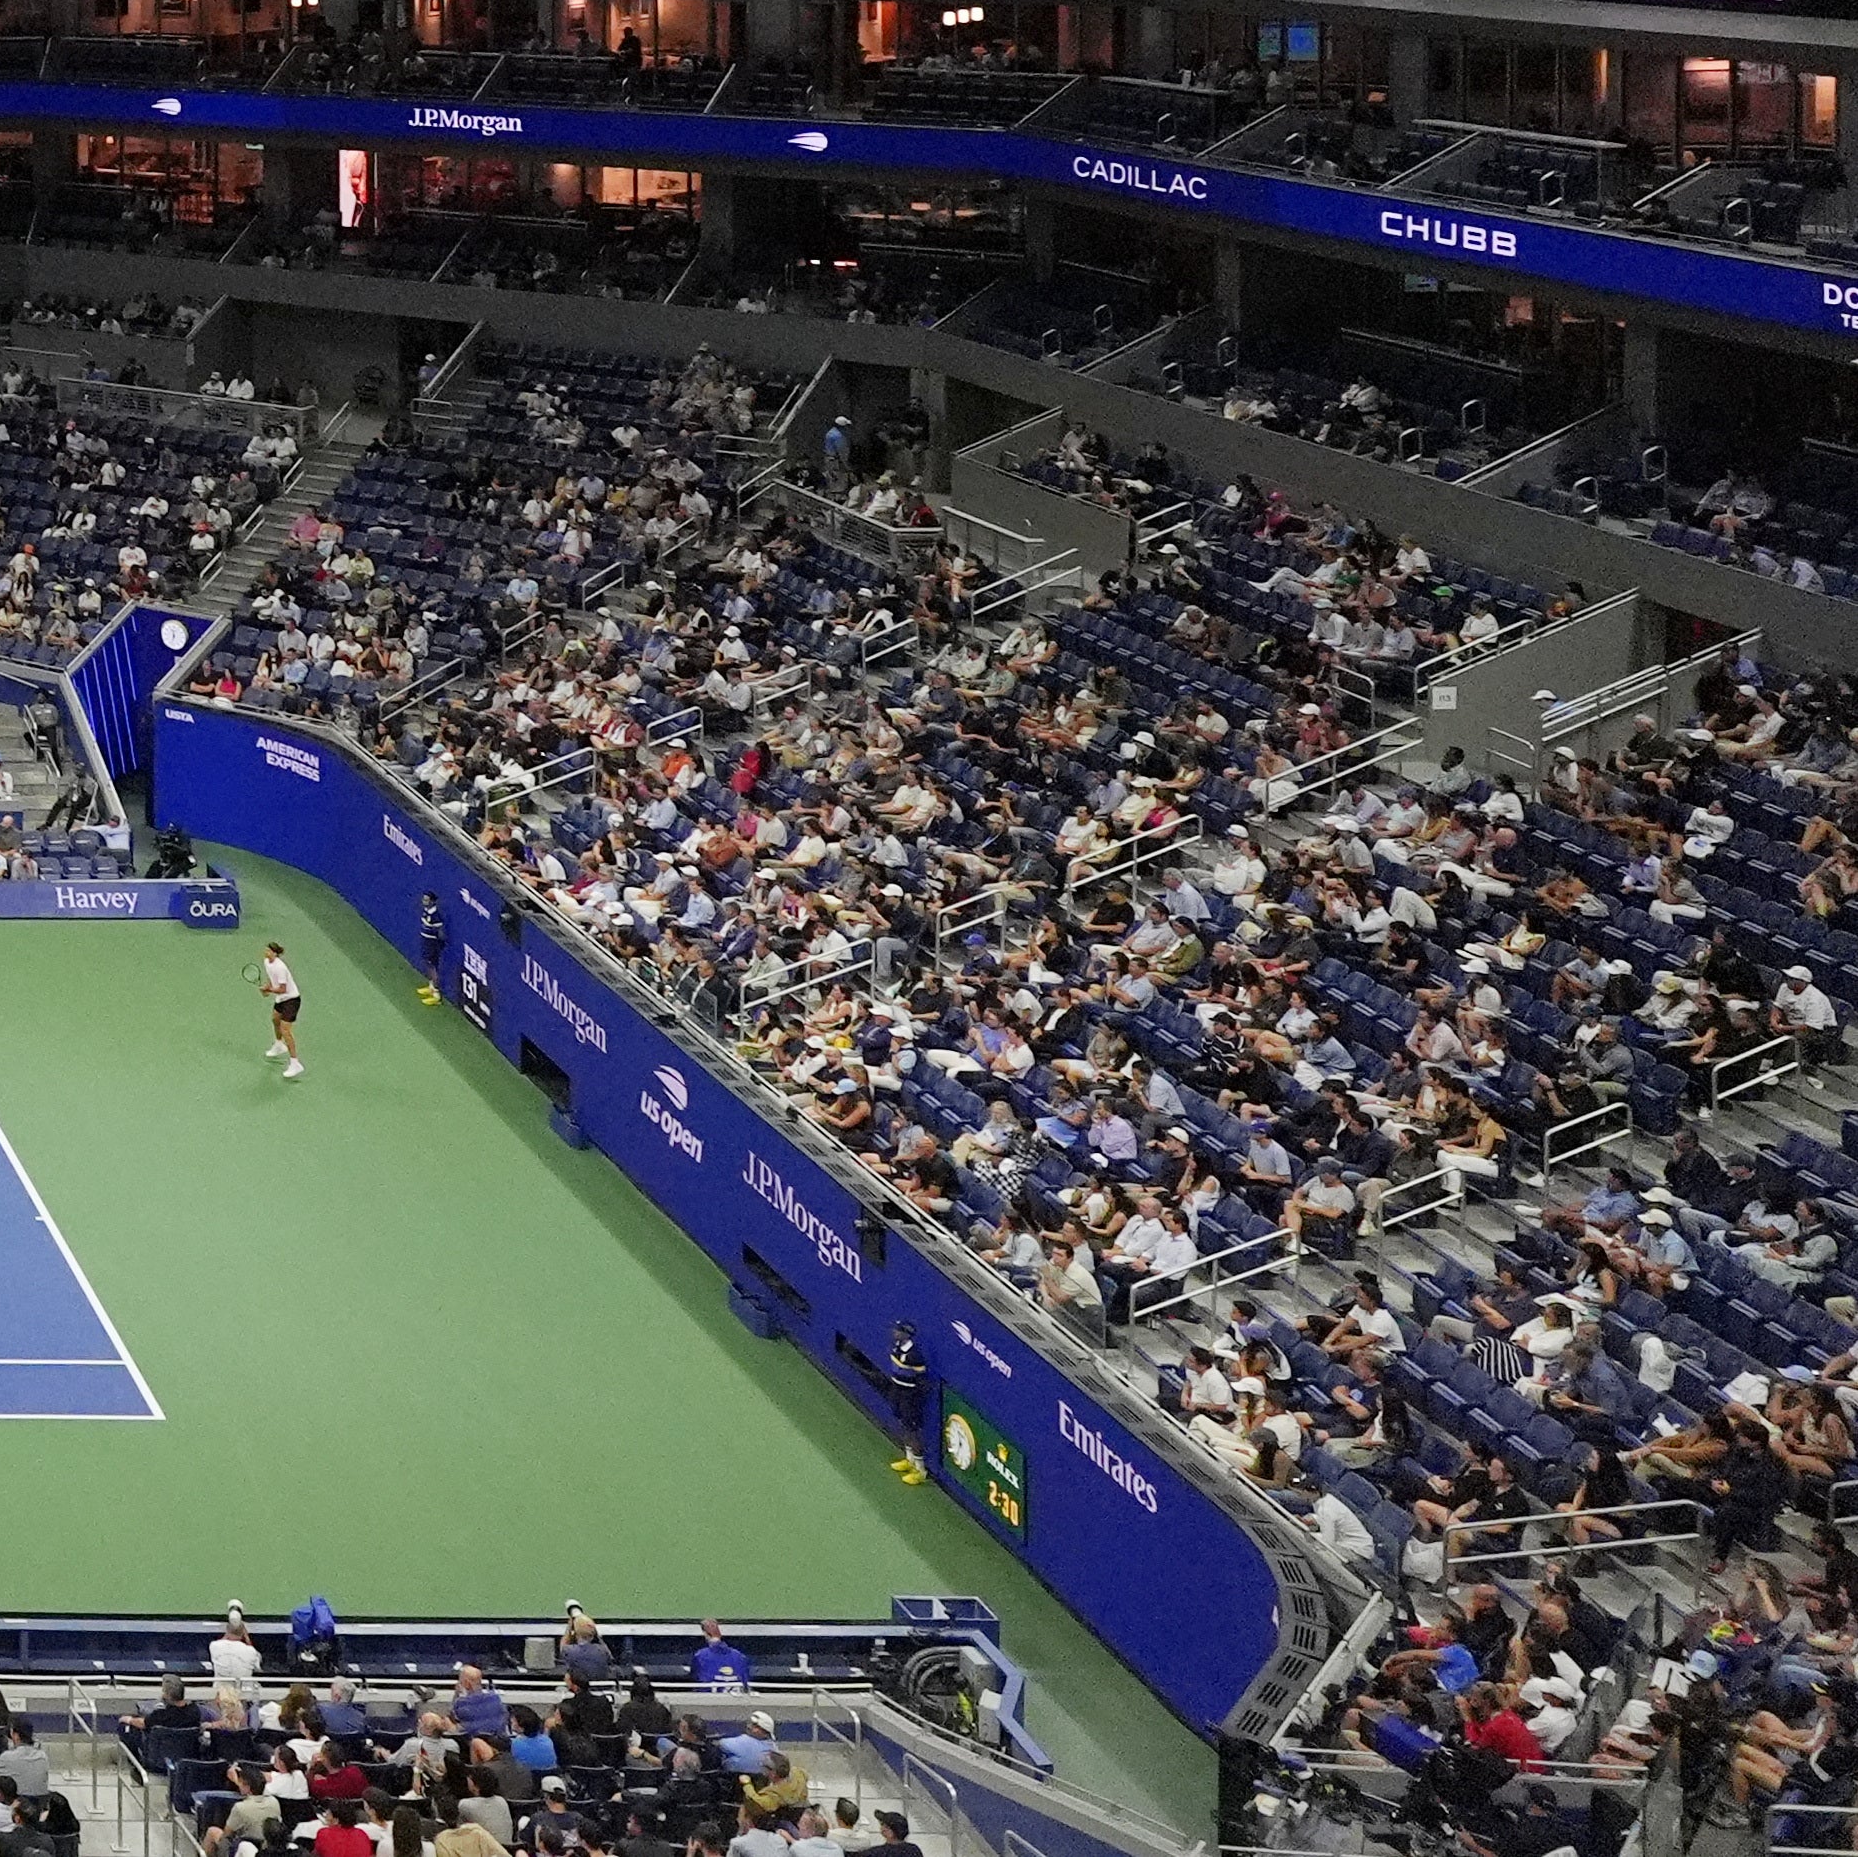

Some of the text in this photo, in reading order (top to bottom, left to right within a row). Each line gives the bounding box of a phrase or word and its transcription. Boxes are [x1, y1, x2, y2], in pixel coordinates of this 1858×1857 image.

[408, 107, 523, 137] J.P.Morgan
[1073, 156, 1209, 200] CADILLAC
[1380, 210, 1517, 257] CHUBB
[164, 708, 195, 724] USTA
[256, 736, 320, 769] AMERICAN
[265, 751, 321, 782] EXPRESS
[383, 813, 423, 866] Emirates
[55, 884, 139, 914] Harvey
[462, 972, 478, 1003] 131
[520, 953, 608, 1054] J.P.Morgan
[640, 1090, 704, 1164] us open
[742, 1149, 863, 1284] J.P.Morgan
[972, 1335, 1012, 1379] us open
[986, 1450, 1020, 1490] ROLEX
[1057, 1399, 1158, 1514] Emirates
[989, 1480, 1020, 1527] 2:30
